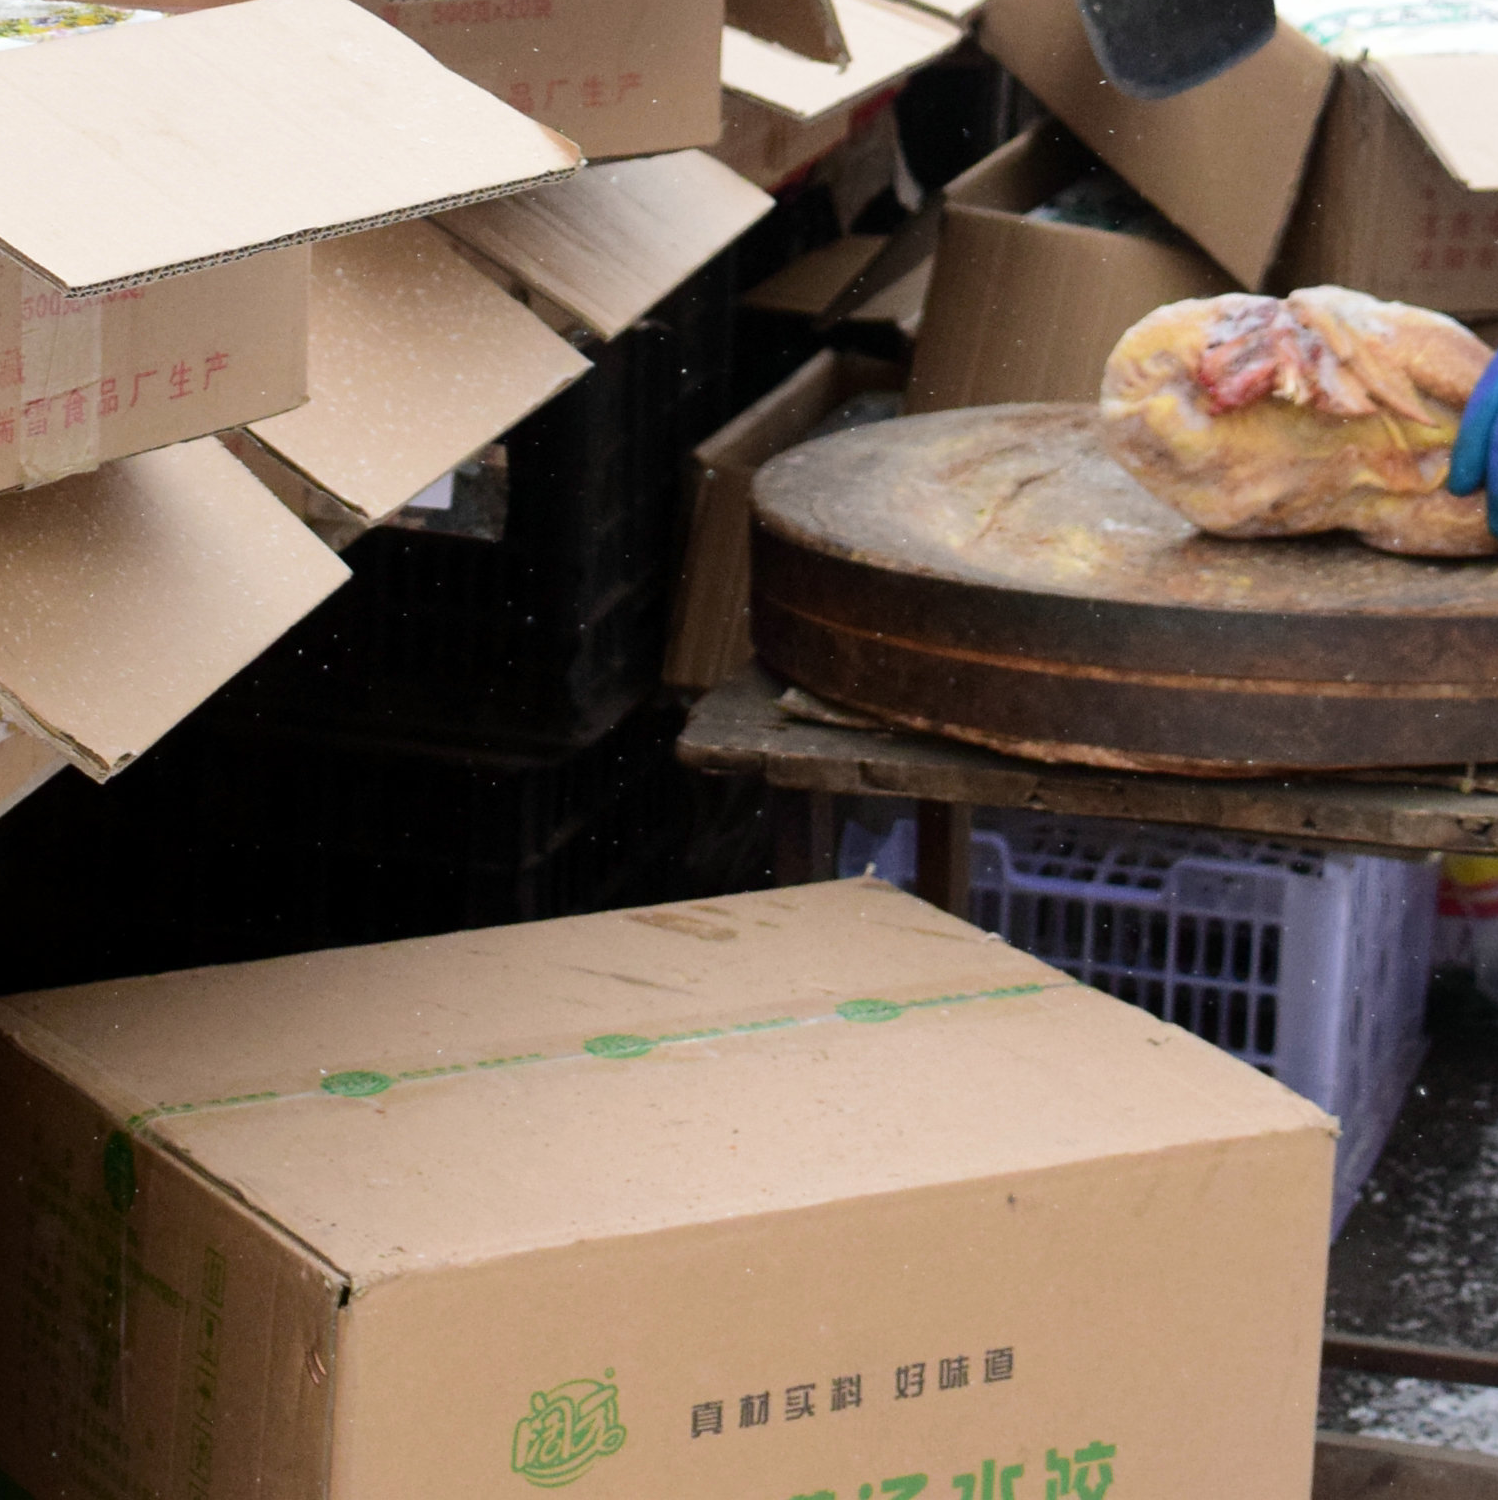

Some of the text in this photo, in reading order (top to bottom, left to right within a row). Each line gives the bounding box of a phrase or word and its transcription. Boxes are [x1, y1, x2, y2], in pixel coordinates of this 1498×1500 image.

[690, 1346, 1016, 1440] 真材实料 好味道
